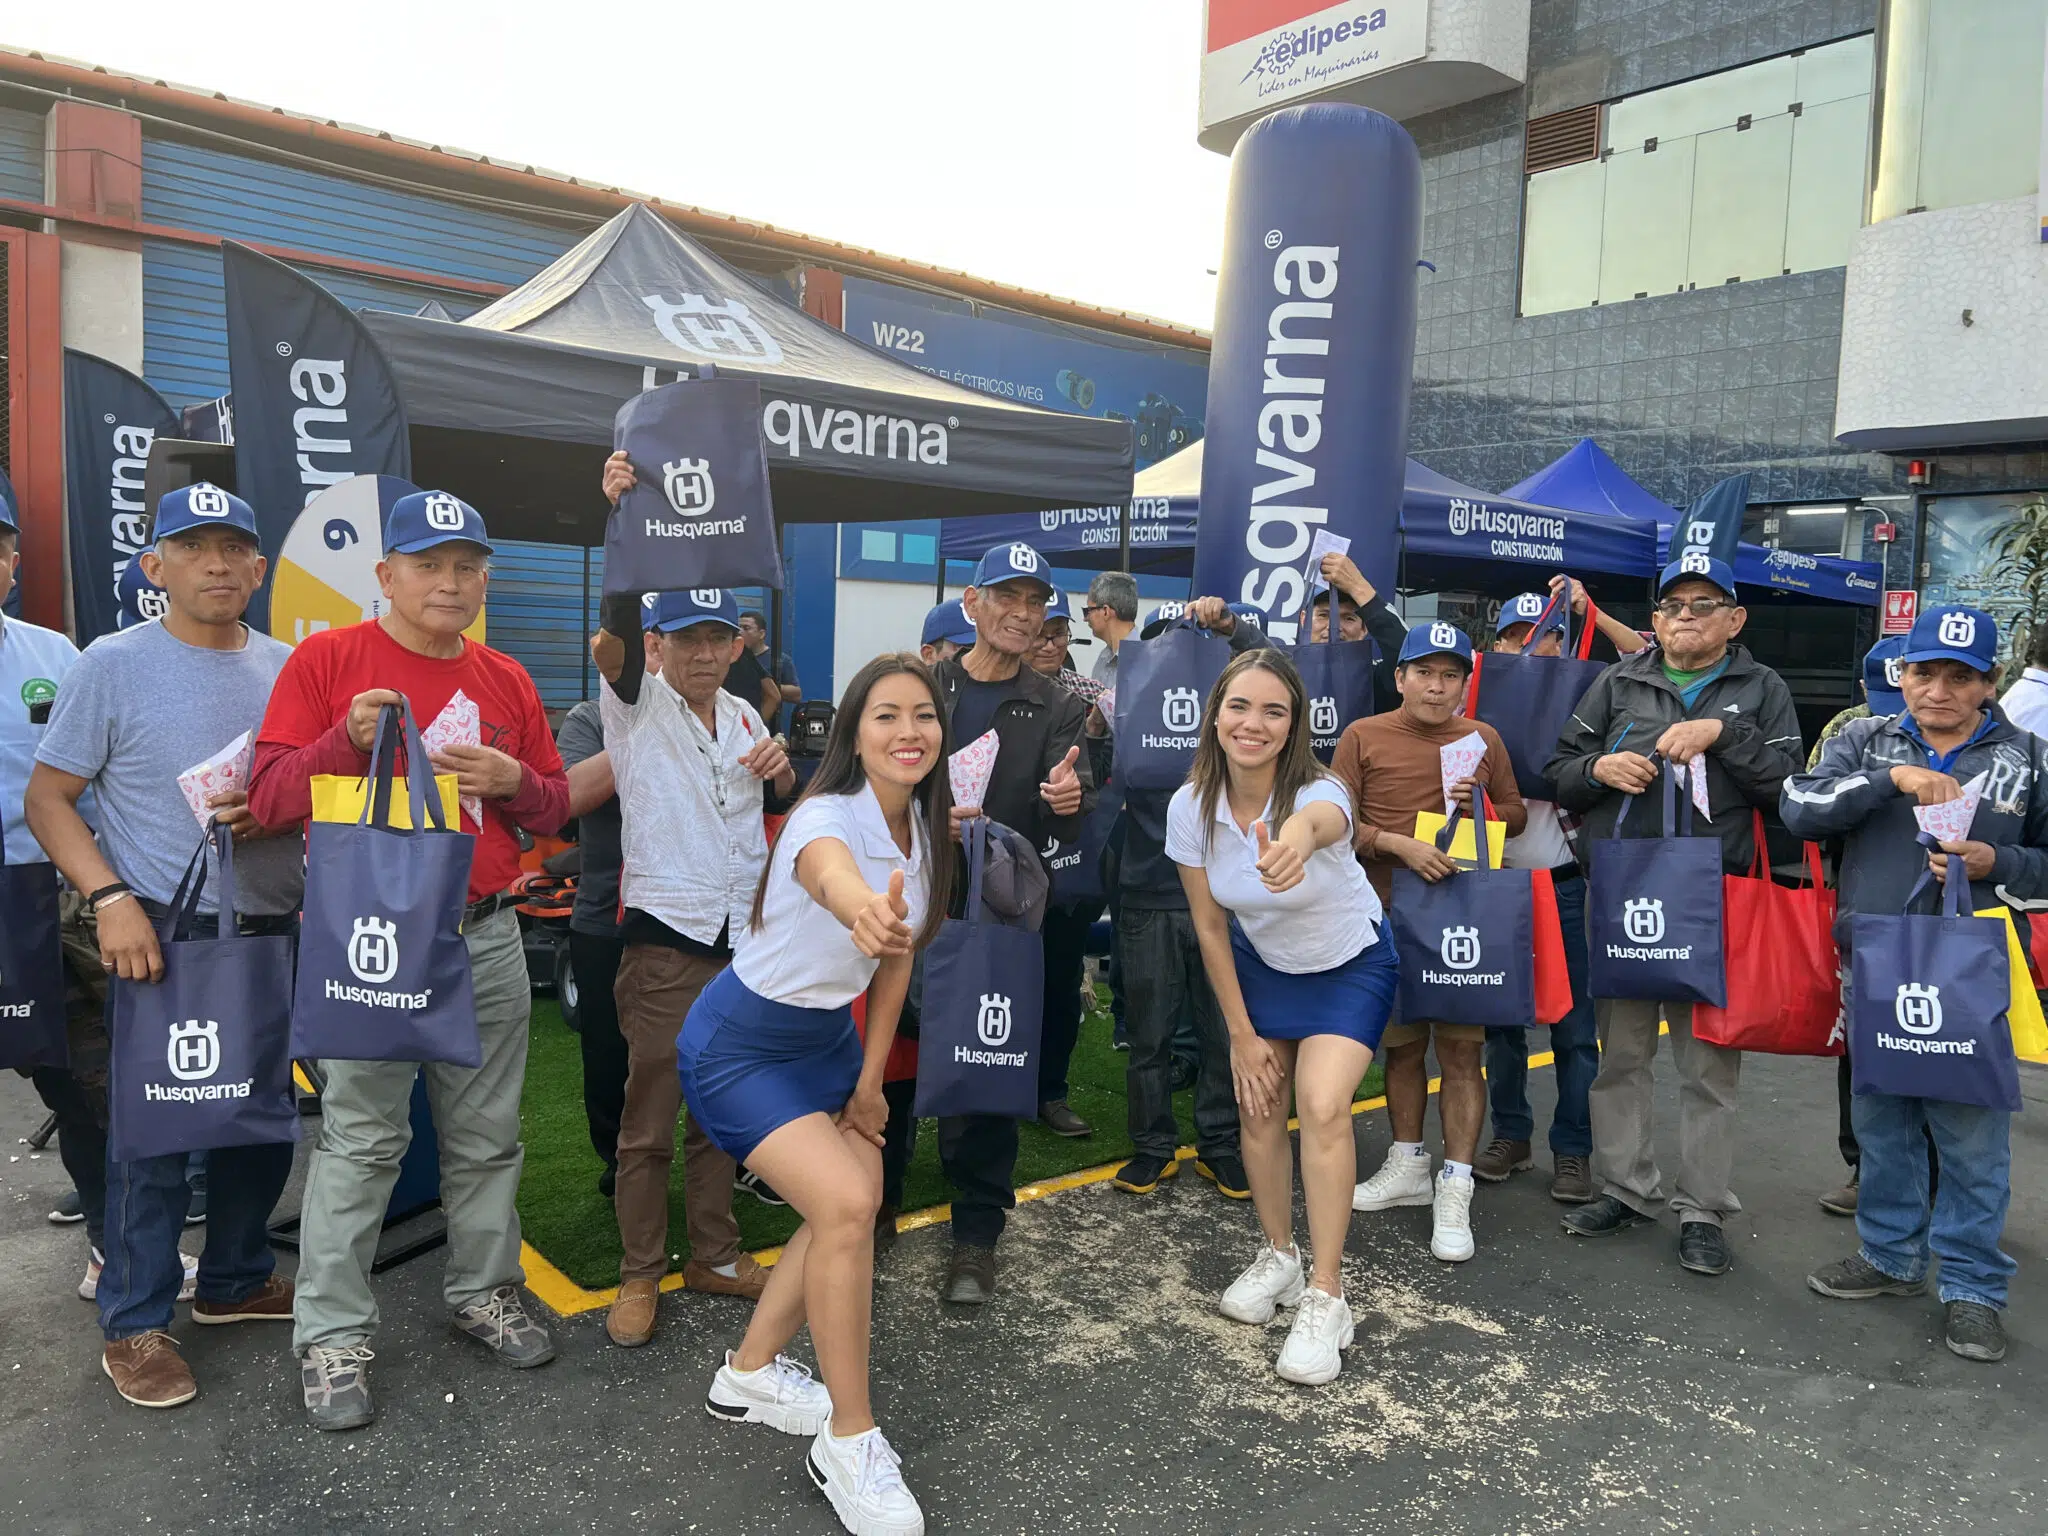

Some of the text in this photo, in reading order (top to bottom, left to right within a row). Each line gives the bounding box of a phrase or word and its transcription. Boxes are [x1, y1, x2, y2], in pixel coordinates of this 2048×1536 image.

[1275, 8, 1387, 63] edipesa
[1288, 75, 1302, 87] en
[1304, 49, 1380, 81] Maquinarias
[872, 321, 925, 354] W22
[1016, 384, 1044, 401] WEG
[1082, 523, 1169, 545] CONSTUCCIÓN
[1491, 540, 1564, 561] CONSTRUCCIÓN
